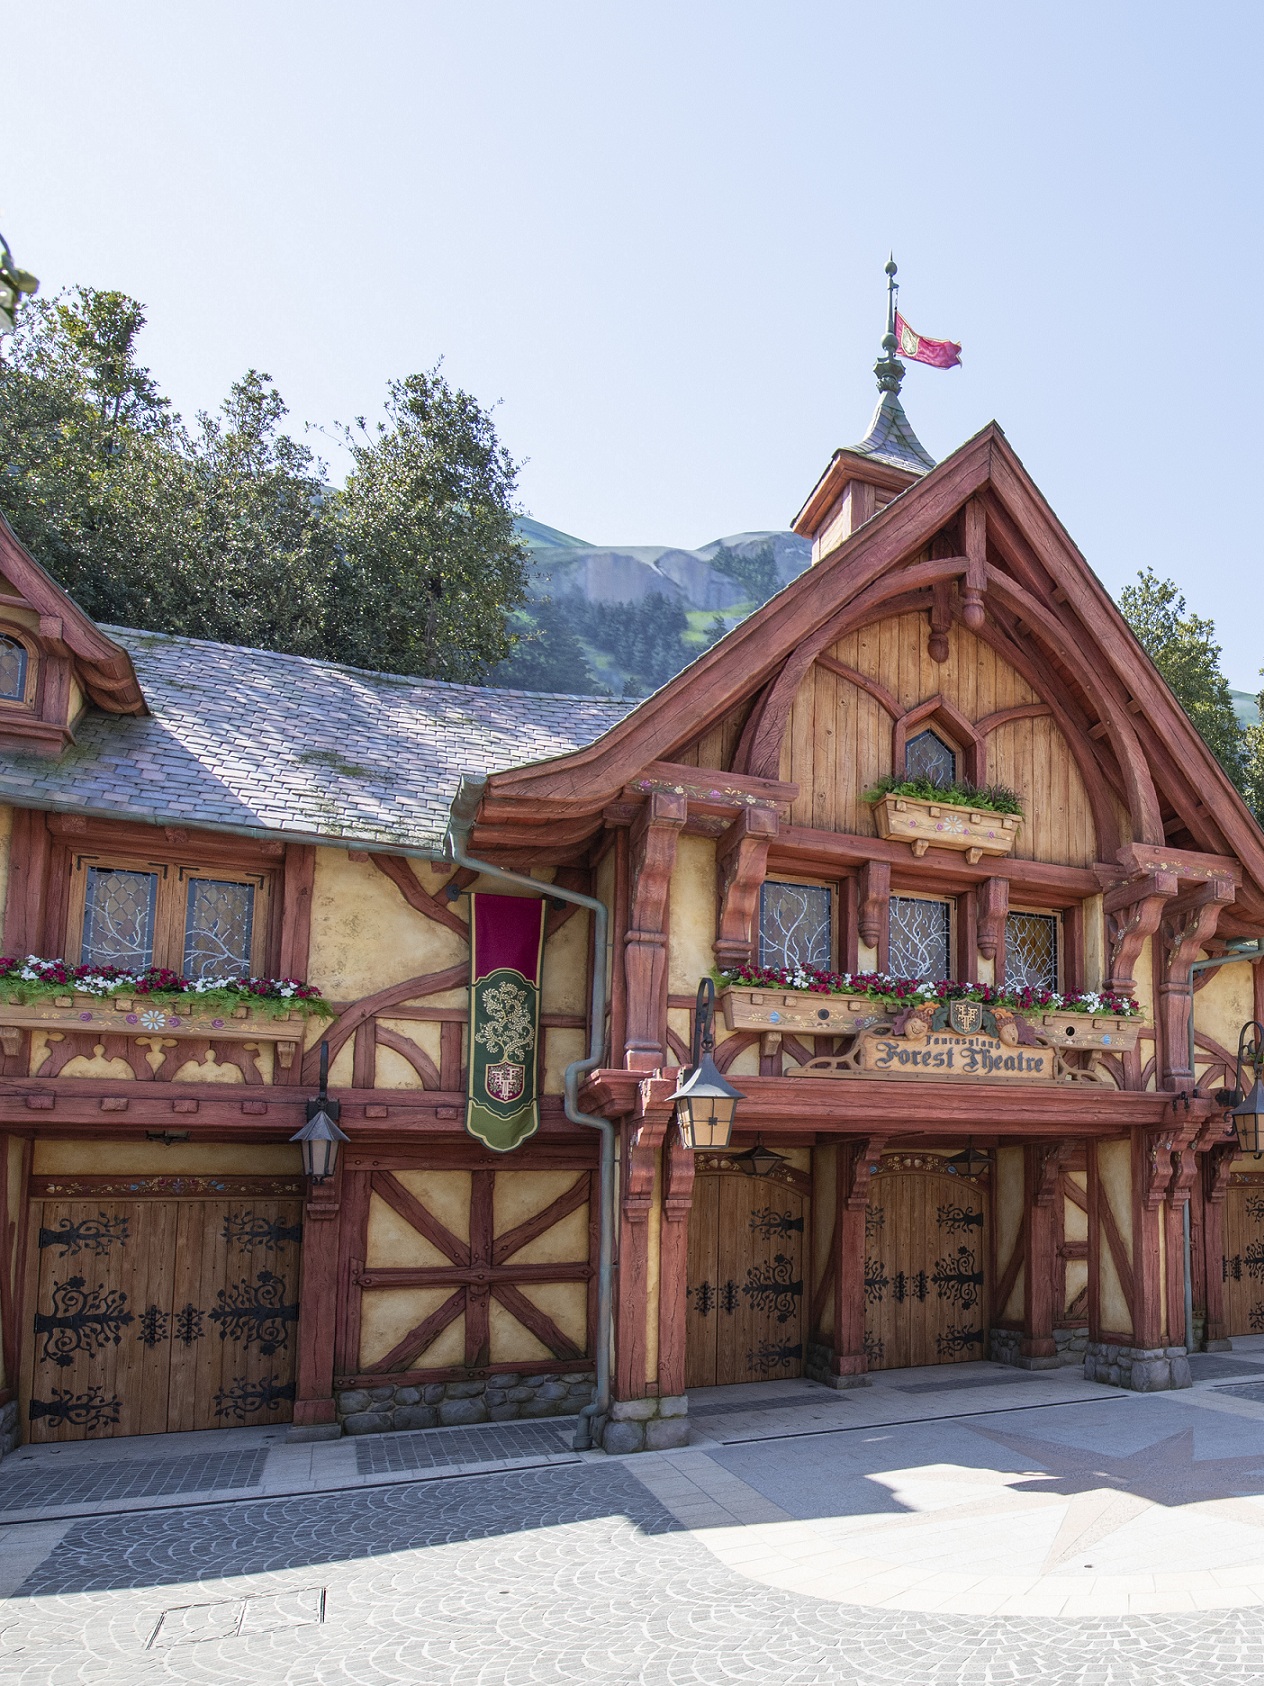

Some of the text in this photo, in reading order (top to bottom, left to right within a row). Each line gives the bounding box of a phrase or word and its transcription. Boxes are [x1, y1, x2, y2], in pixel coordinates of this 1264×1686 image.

[925, 1034, 1001, 1050] Fantasyland
[875, 1042, 1044, 1074] Forest Theatre
